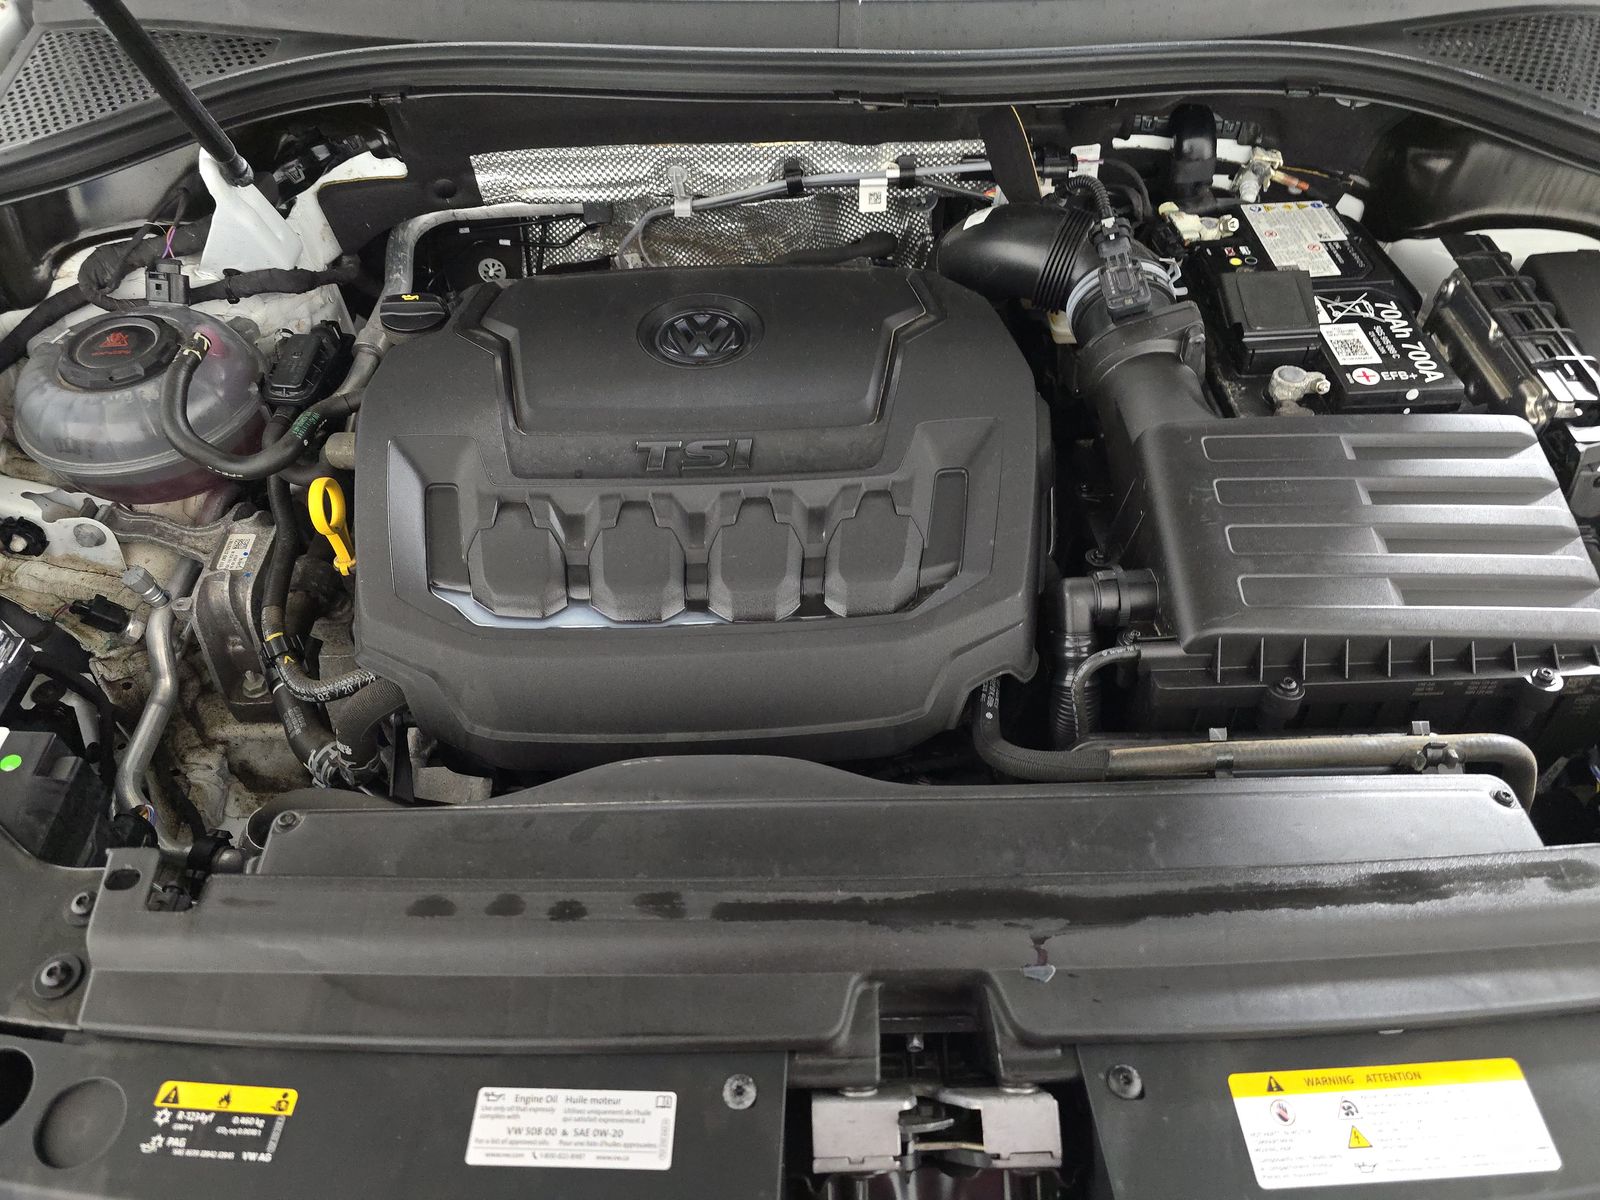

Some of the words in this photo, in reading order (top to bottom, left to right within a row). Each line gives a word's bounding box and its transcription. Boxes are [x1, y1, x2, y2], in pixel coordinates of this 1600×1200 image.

[1375, 300, 1413, 338] 70Ah
[1401, 341, 1444, 383] 700A
[1381, 370, 1418, 381] EFB+
[636, 438, 753, 471] TSI
[1304, 1074, 1355, 1087] WARNING
[1365, 1071, 1422, 1084] ATTENTION
[514, 1094, 543, 1105] Engine
[545, 1094, 559, 1104] Oil
[565, 1095, 588, 1105] Huile
[590, 1096, 622, 1105] moteur
[507, 1127, 523, 1135] VW
[525, 1127, 543, 1136] 508
[544, 1127, 558, 1136] 00
[561, 1128, 569, 1136] &
[573, 1128, 591, 1137] SAE
[592, 1129, 624, 1138] 0W-20
[241, 1151, 258, 1162] VW
[257, 1152, 273, 1163] AG
